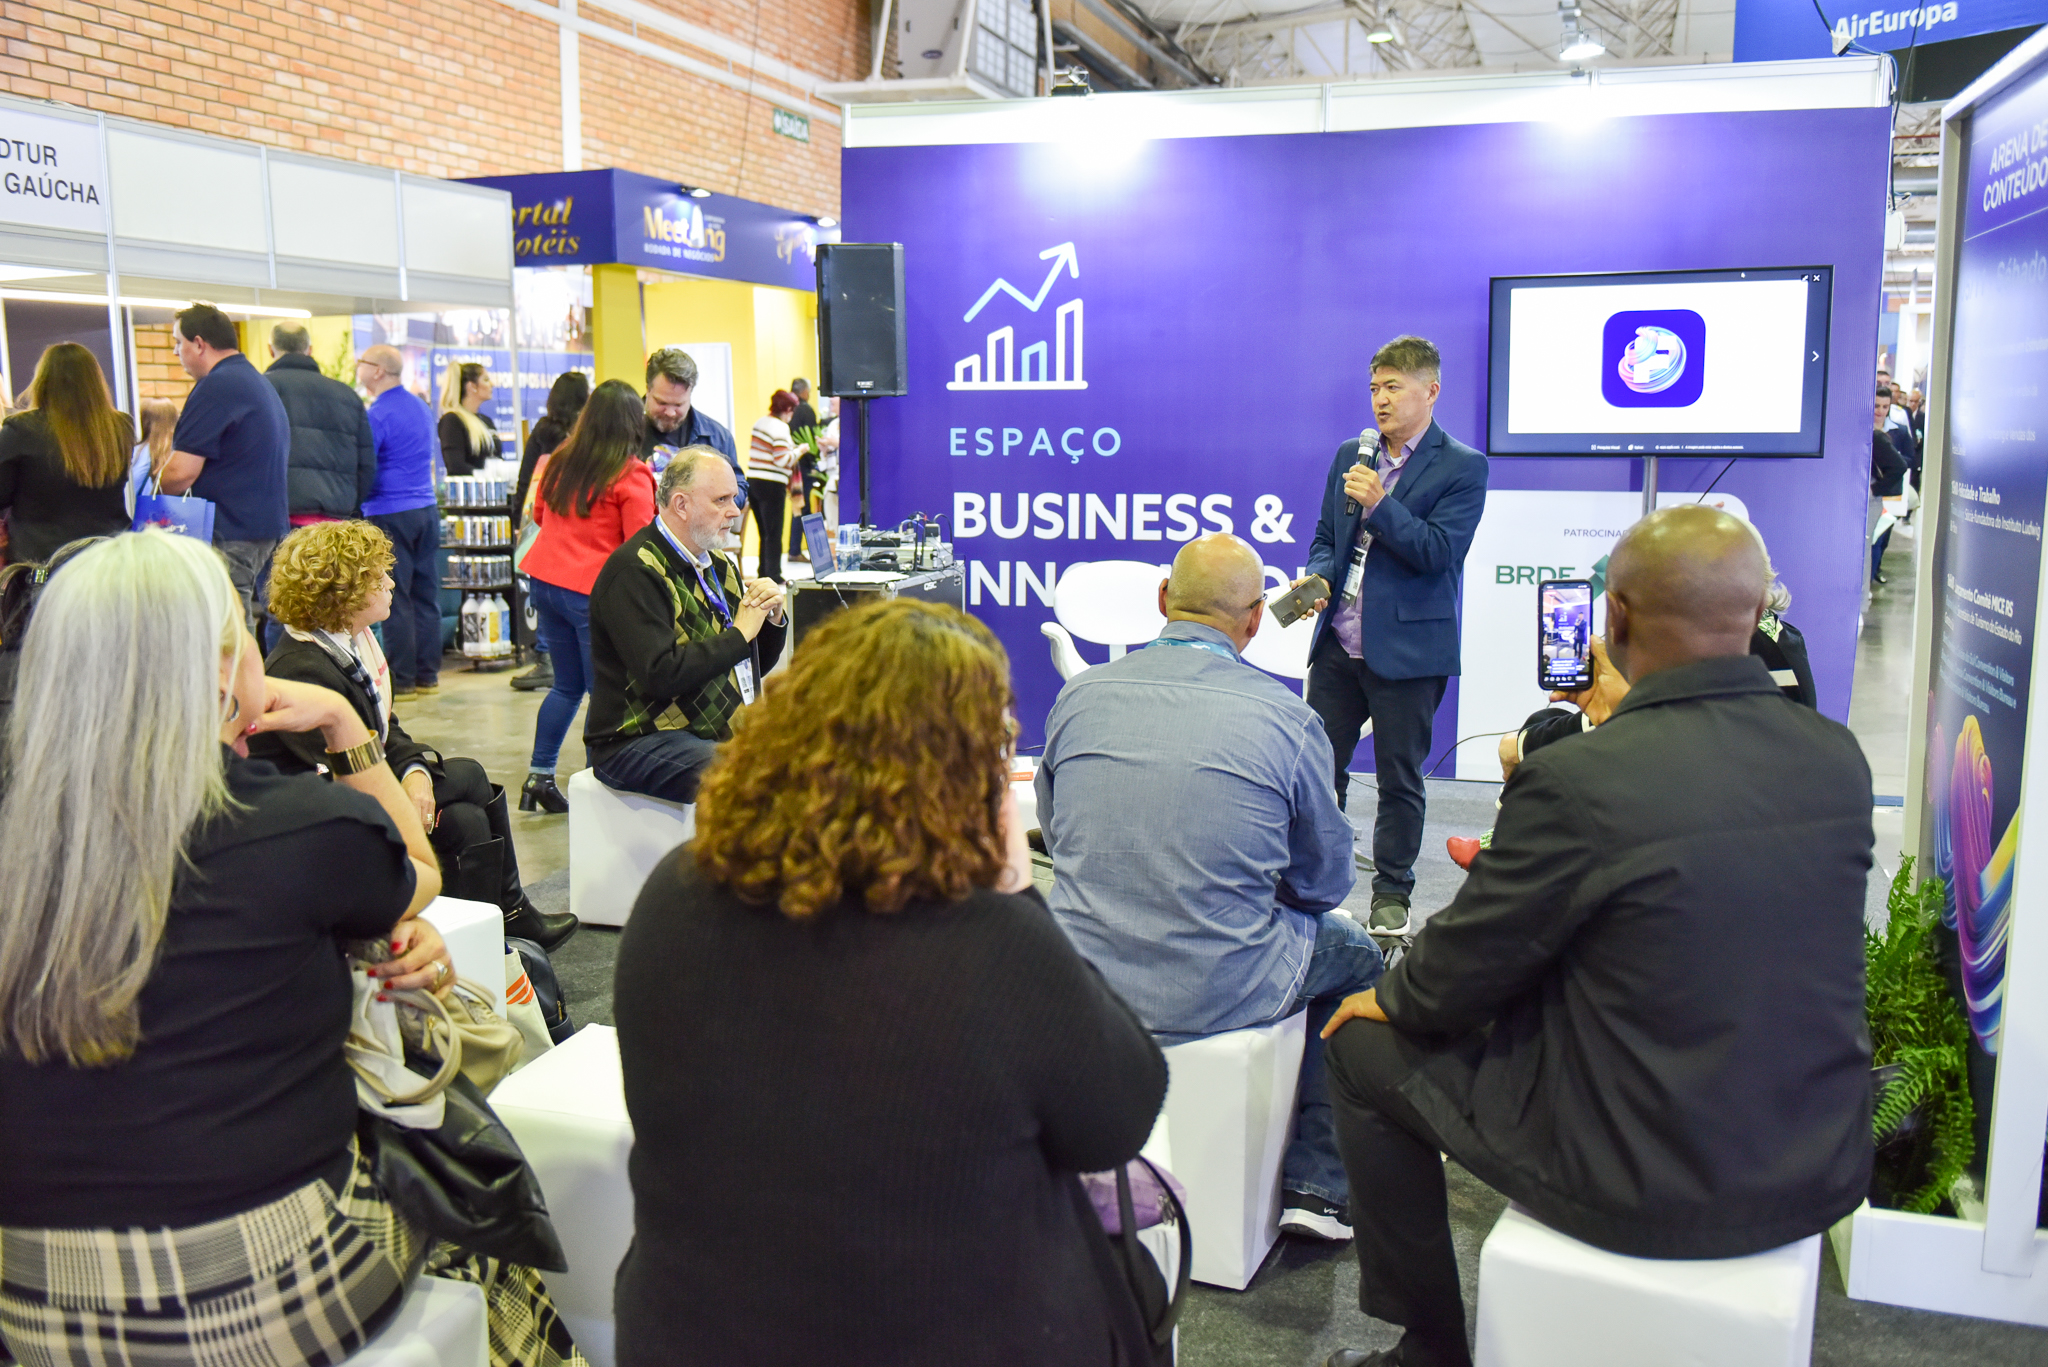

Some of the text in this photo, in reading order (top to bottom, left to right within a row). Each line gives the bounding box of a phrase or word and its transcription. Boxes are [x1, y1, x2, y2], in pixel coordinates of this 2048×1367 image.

[1834, 1, 1958, 40] AirEuropa
[1989, 117, 2048, 176] ARENA DE
[4, 171, 100, 206] GAÚCHA
[1983, 155, 2048, 213] CONTEÚDO
[513, 228, 580, 257] otéis
[949, 426, 1122, 465] ESPAÇO
[953, 491, 1296, 543] BUSINESS &
